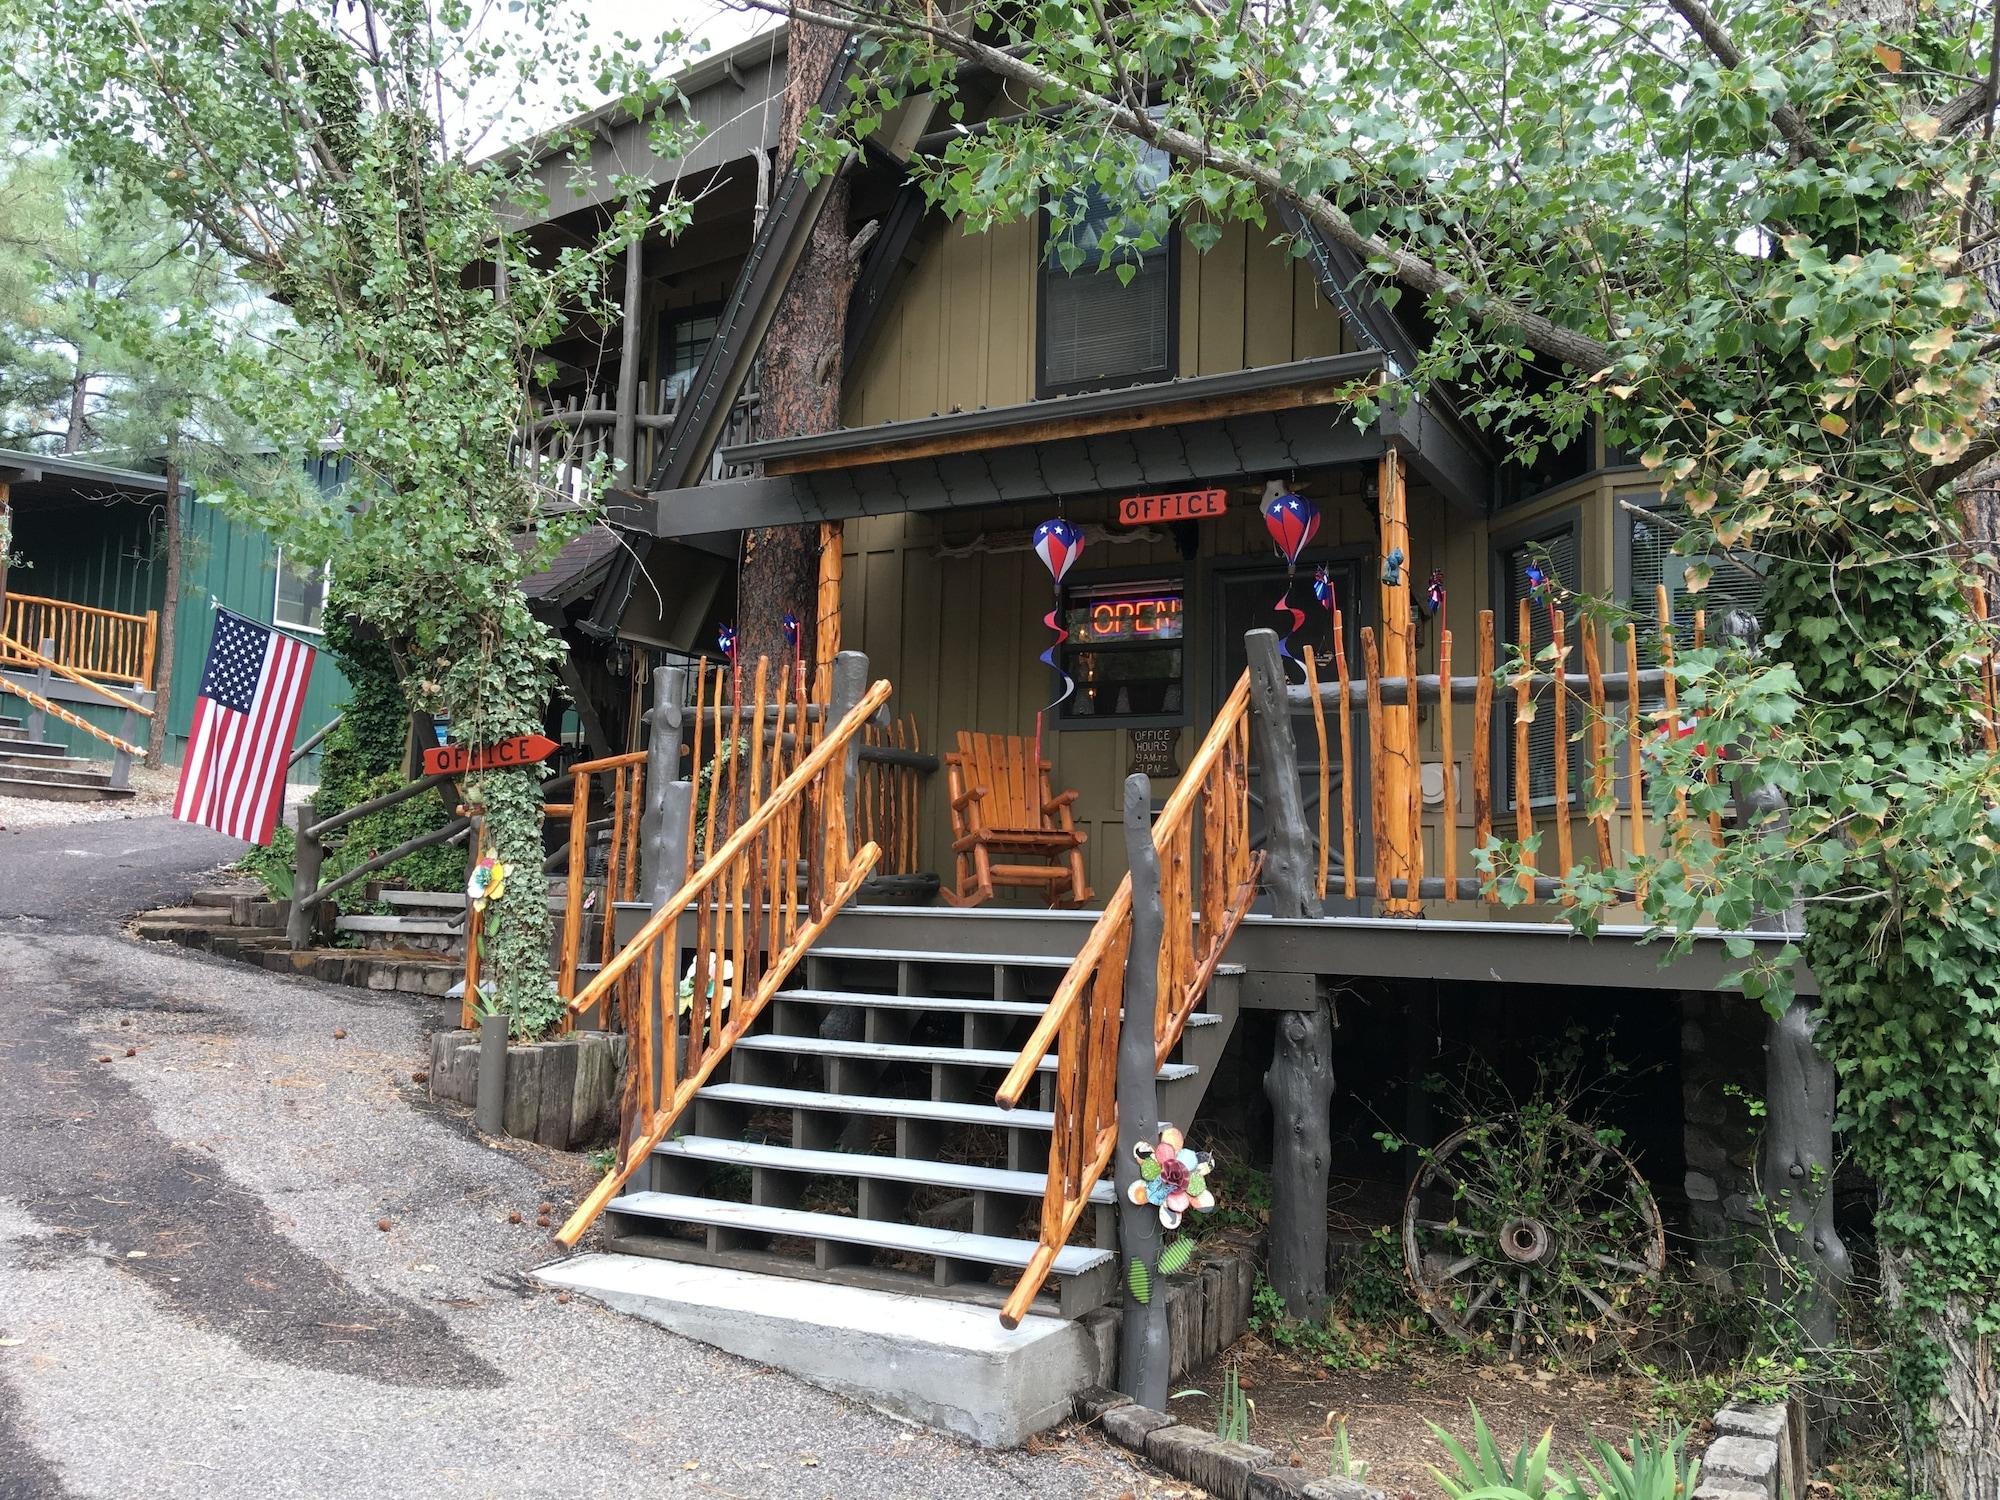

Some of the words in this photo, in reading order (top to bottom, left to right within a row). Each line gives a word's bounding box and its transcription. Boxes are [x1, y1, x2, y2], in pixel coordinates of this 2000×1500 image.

[1125, 493, 1218, 519] OFFICE
[1093, 599, 1175, 634] OPEN
[1135, 730, 1170, 741] OFFICE
[1136, 741, 1168, 752] HOURS
